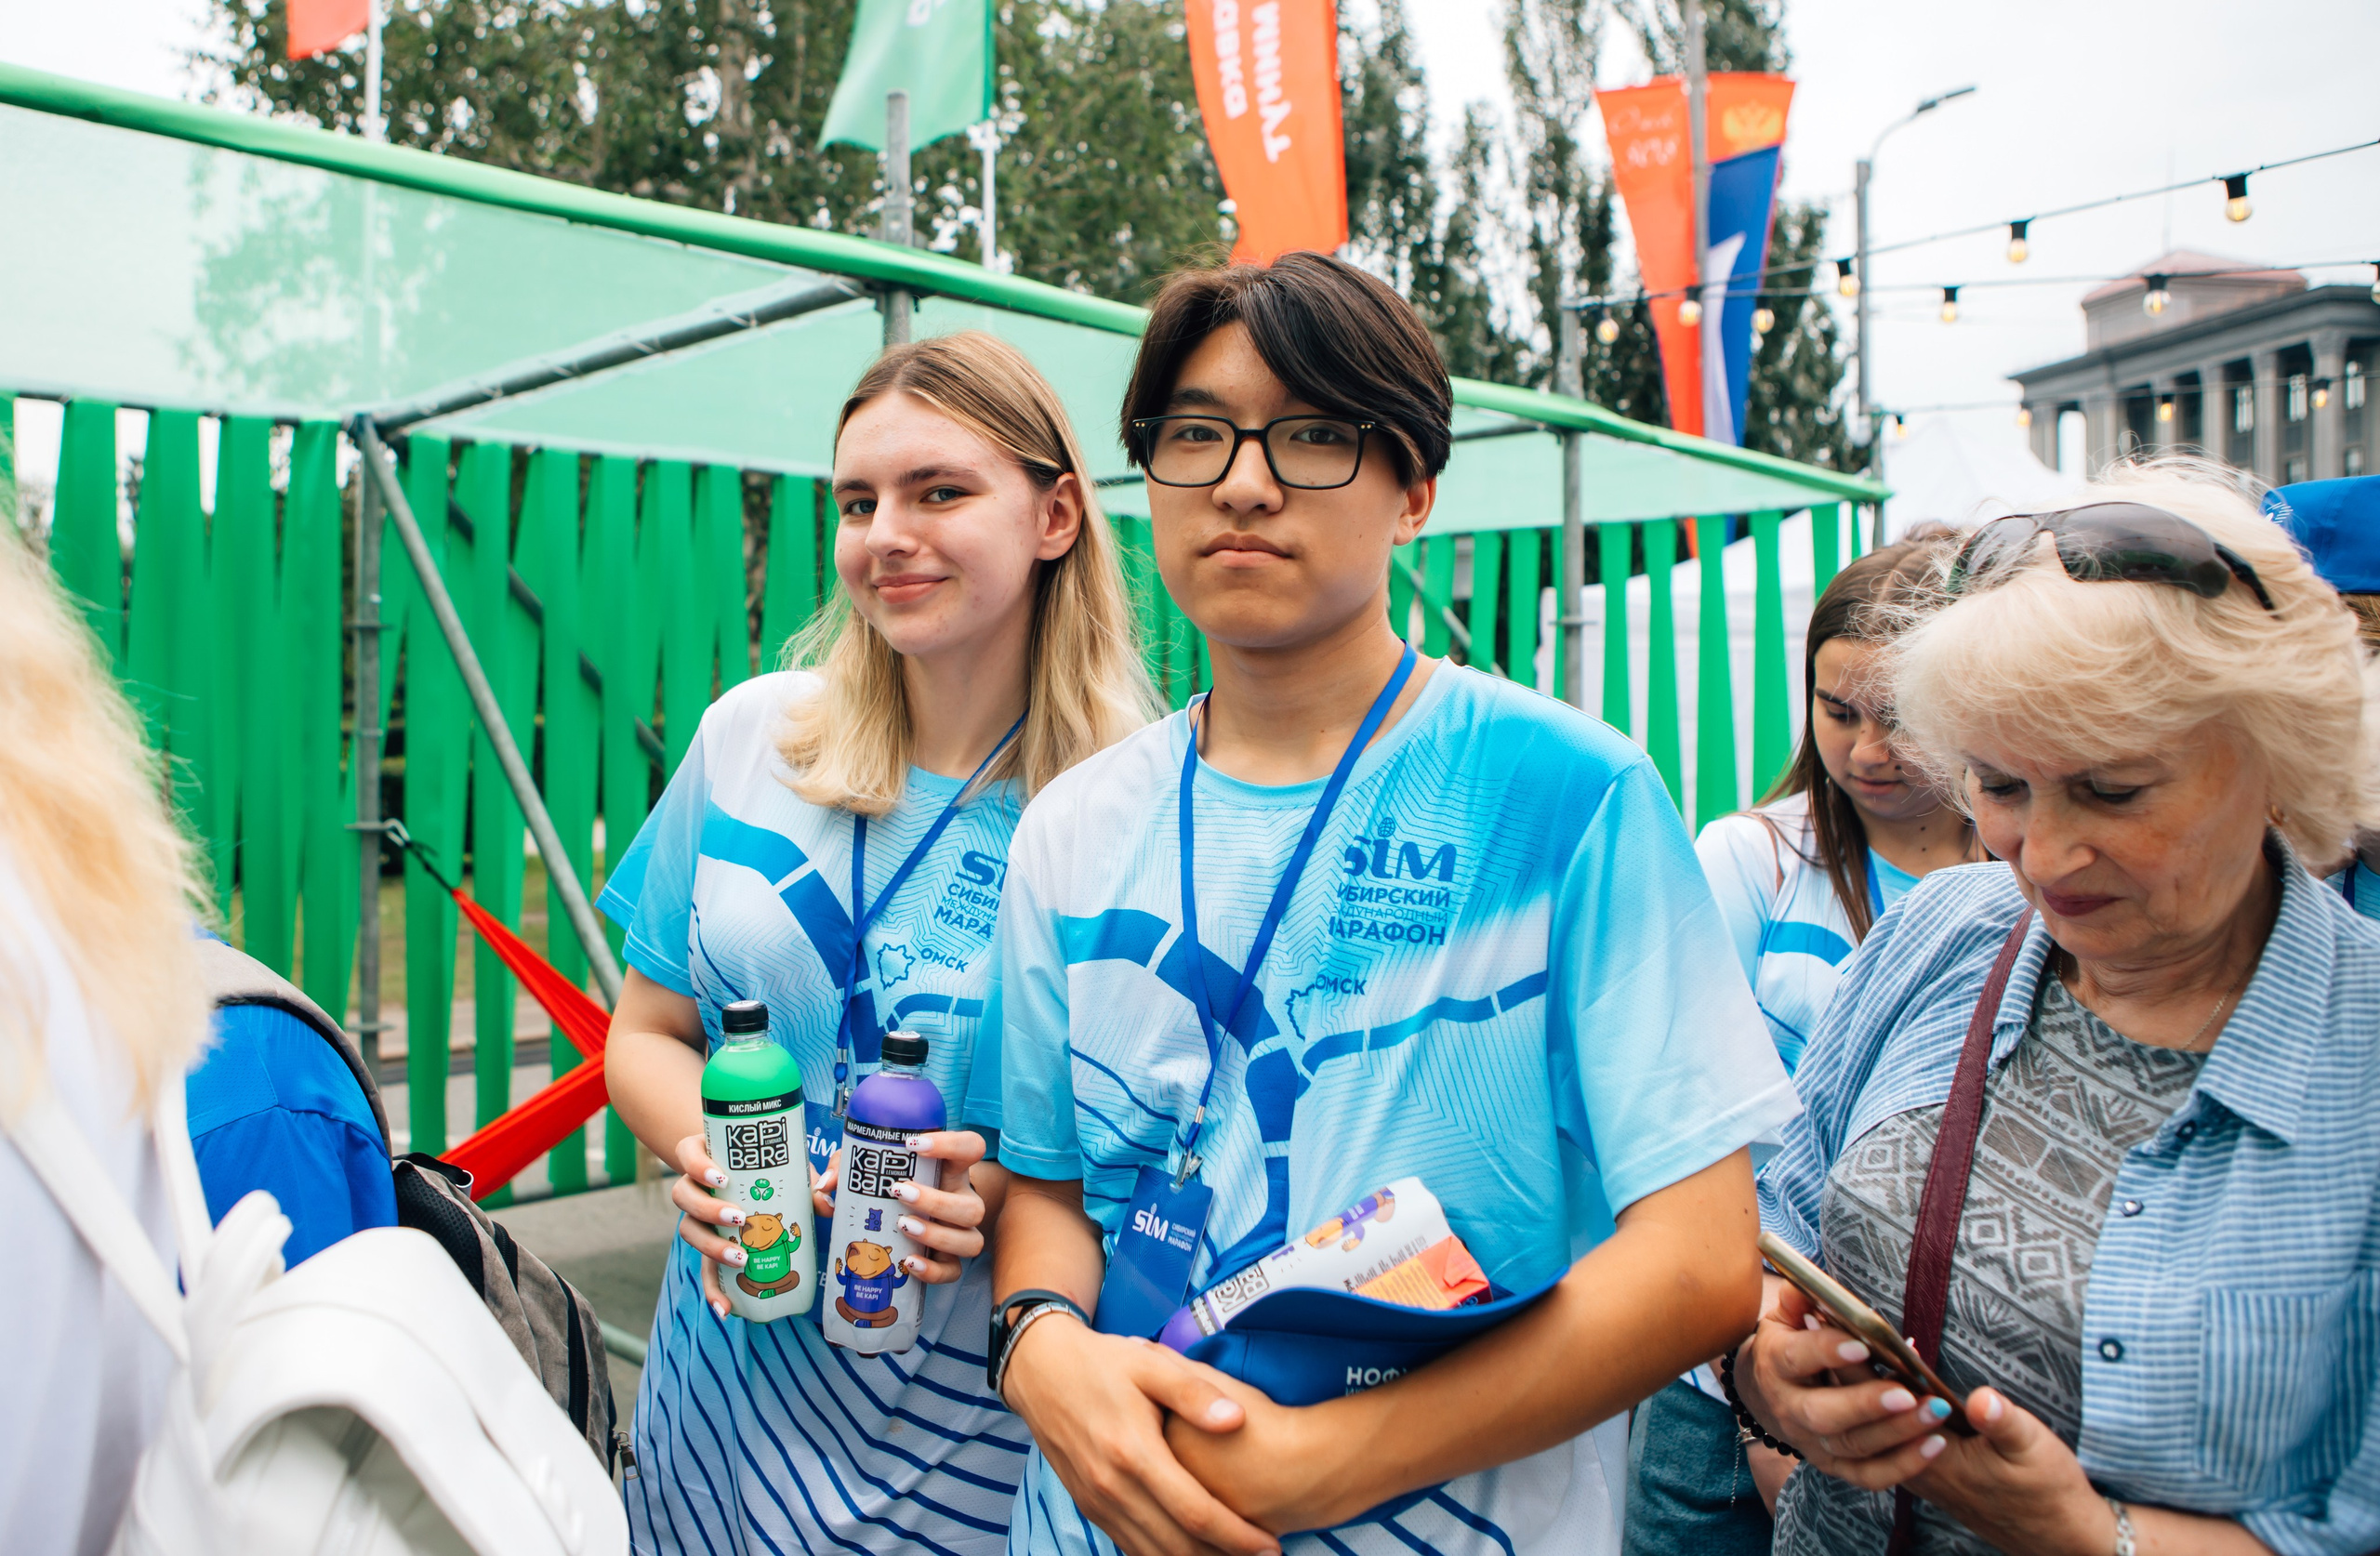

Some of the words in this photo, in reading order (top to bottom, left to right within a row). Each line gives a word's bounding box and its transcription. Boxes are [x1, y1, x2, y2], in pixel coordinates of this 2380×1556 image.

[920, 947, 969, 973] ОМСК
[1316, 973, 1367, 996] ОМСК
[728, 1101, 762, 1114] КИСЛЫЙ
[762, 1099, 782, 1111] МИКС
[847, 1120, 901, 1141] МАРМЕЛАДНЫЕ
[760, 1255, 781, 1264] HAPPY
[853, 1284, 863, 1292] BE
[863, 1285, 883, 1294] HAPPY
[855, 1291, 865, 1299] BE
[864, 1292, 879, 1300] KAPI
